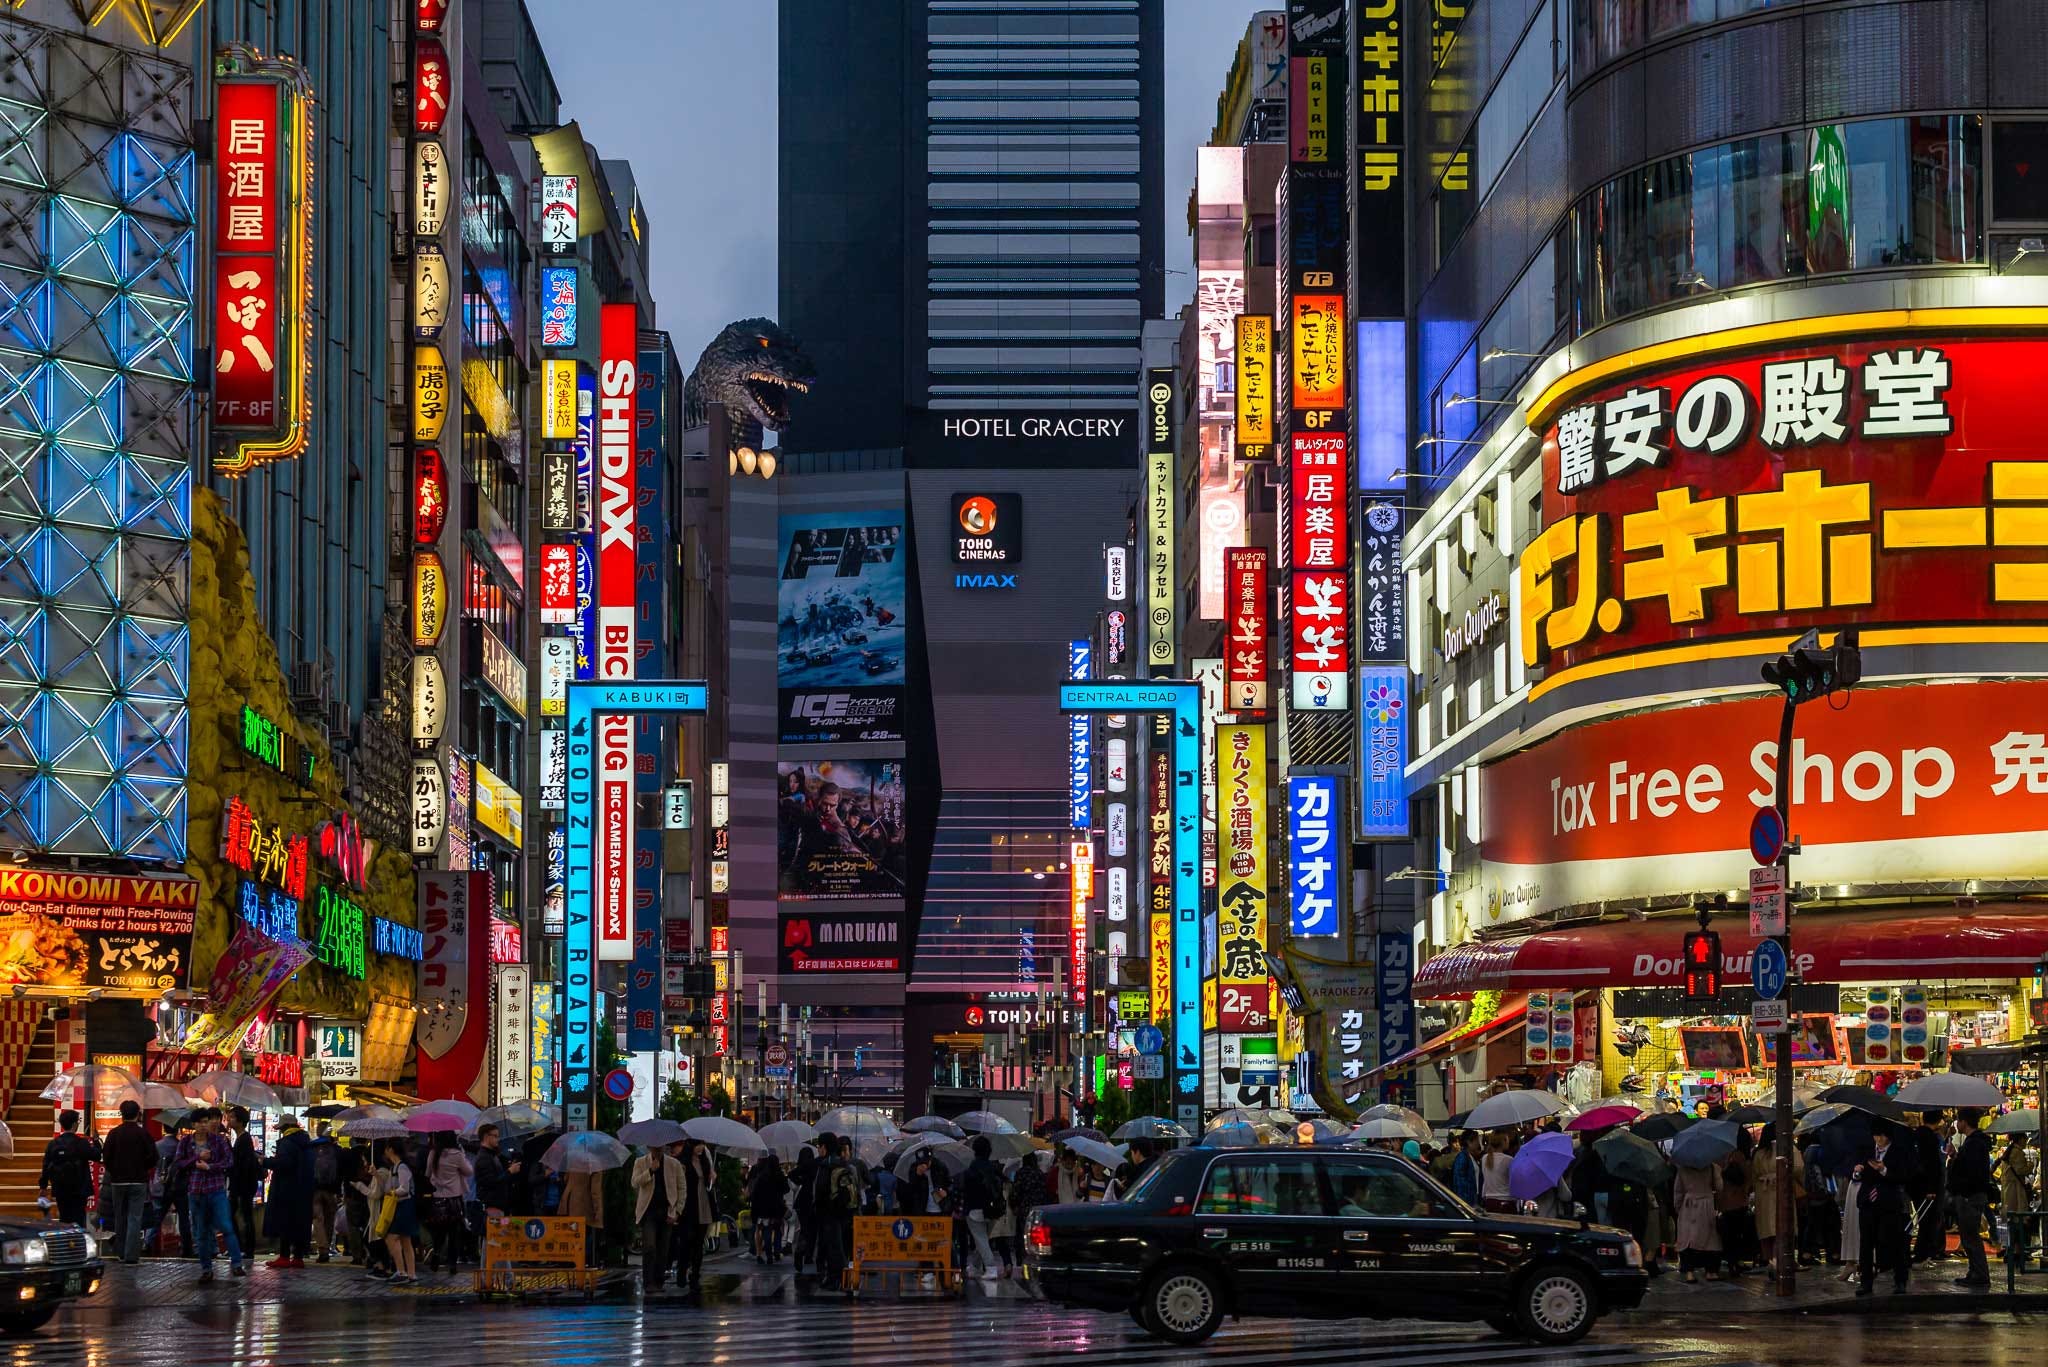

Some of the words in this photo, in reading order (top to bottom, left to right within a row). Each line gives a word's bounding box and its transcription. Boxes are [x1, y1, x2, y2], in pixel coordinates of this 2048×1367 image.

[420, 20, 437, 28] 8F
[418, 62, 446, 110] つぼ八
[418, 122, 438, 130] 7F
[228, 119, 265, 241] 居酒屋
[417, 220, 440, 233] 6F
[552, 243, 566, 252] 8F
[1306, 273, 1330, 285] 7F
[217, 270, 273, 373] つぼ八
[544, 280, 575, 345] 海の家
[421, 327, 435, 335] 5F
[944, 419, 1016, 437] HOTEL
[1021, 418, 1125, 437] GRACERY
[1305, 411, 1332, 428] 6F
[1557, 348, 1952, 494] 驚安の殿堂
[417, 428, 434, 437] 4F
[601, 360, 635, 551] SHIDAX
[1245, 445, 1264, 457] 6F
[547, 457, 568, 519] 山内農場
[1305, 474, 1335, 566] 居楽屋
[959, 538, 992, 549] TOHO
[959, 550, 1005, 559] CINEMAS
[955, 575, 1016, 588] IMAX
[1111, 557, 1121, 595] 東京ビル
[1241, 572, 1255, 614] 居楽屋
[1444, 624, 1467, 664] Don
[1464, 592, 1502, 648] Quijote
[605, 625, 629, 677] BIC
[791, 694, 851, 717] ICE
[1067, 692, 1133, 702] CENTRAL
[1138, 692, 1177, 702] ROAD
[418, 739, 434, 748] 1F
[1372, 726, 1385, 783] STAGE
[1385, 727, 1399, 774] IDOL
[1748, 738, 1955, 816] Shop
[609, 786, 621, 809] BIC
[1230, 731, 1253, 851] きんくら酒場
[1610, 758, 1724, 820] Free
[415, 776, 437, 830] かっぱ
[1372, 799, 1399, 817] 5F
[1551, 776, 1596, 836] Tax
[417, 837, 434, 847] B1
[570, 742, 589, 926] GODZILLA
[1297, 783, 1333, 929] カラオケ
[131, 878, 198, 906] YAKI
[1178, 769, 1197, 1015] ゴジラロード
[66, 904, 101, 916] dinner
[103, 906, 125, 917] with
[127, 907, 194, 922] Free-Flowing
[64, 917, 98, 928] Drinks
[101, 918, 116, 929] for
[118, 920, 125, 930] 2
[127, 919, 157, 931] hours
[159, 923, 193, 934] ¥2,700
[820, 922, 897, 942] MARUHAN
[1221, 880, 1267, 980] 金の蔵
[104, 975, 157, 987] TORADYU
[160, 978, 173, 986] 2F
[569, 949, 589, 1035] ROAD
[1768, 973, 1777, 990] 40
[1382, 939, 1409, 1057] カラオケ
[93, 1054, 141, 1065] OKONOMI
[1251, 1242, 1270, 1250] 518
[1355, 1260, 1380, 1268] TAXI
